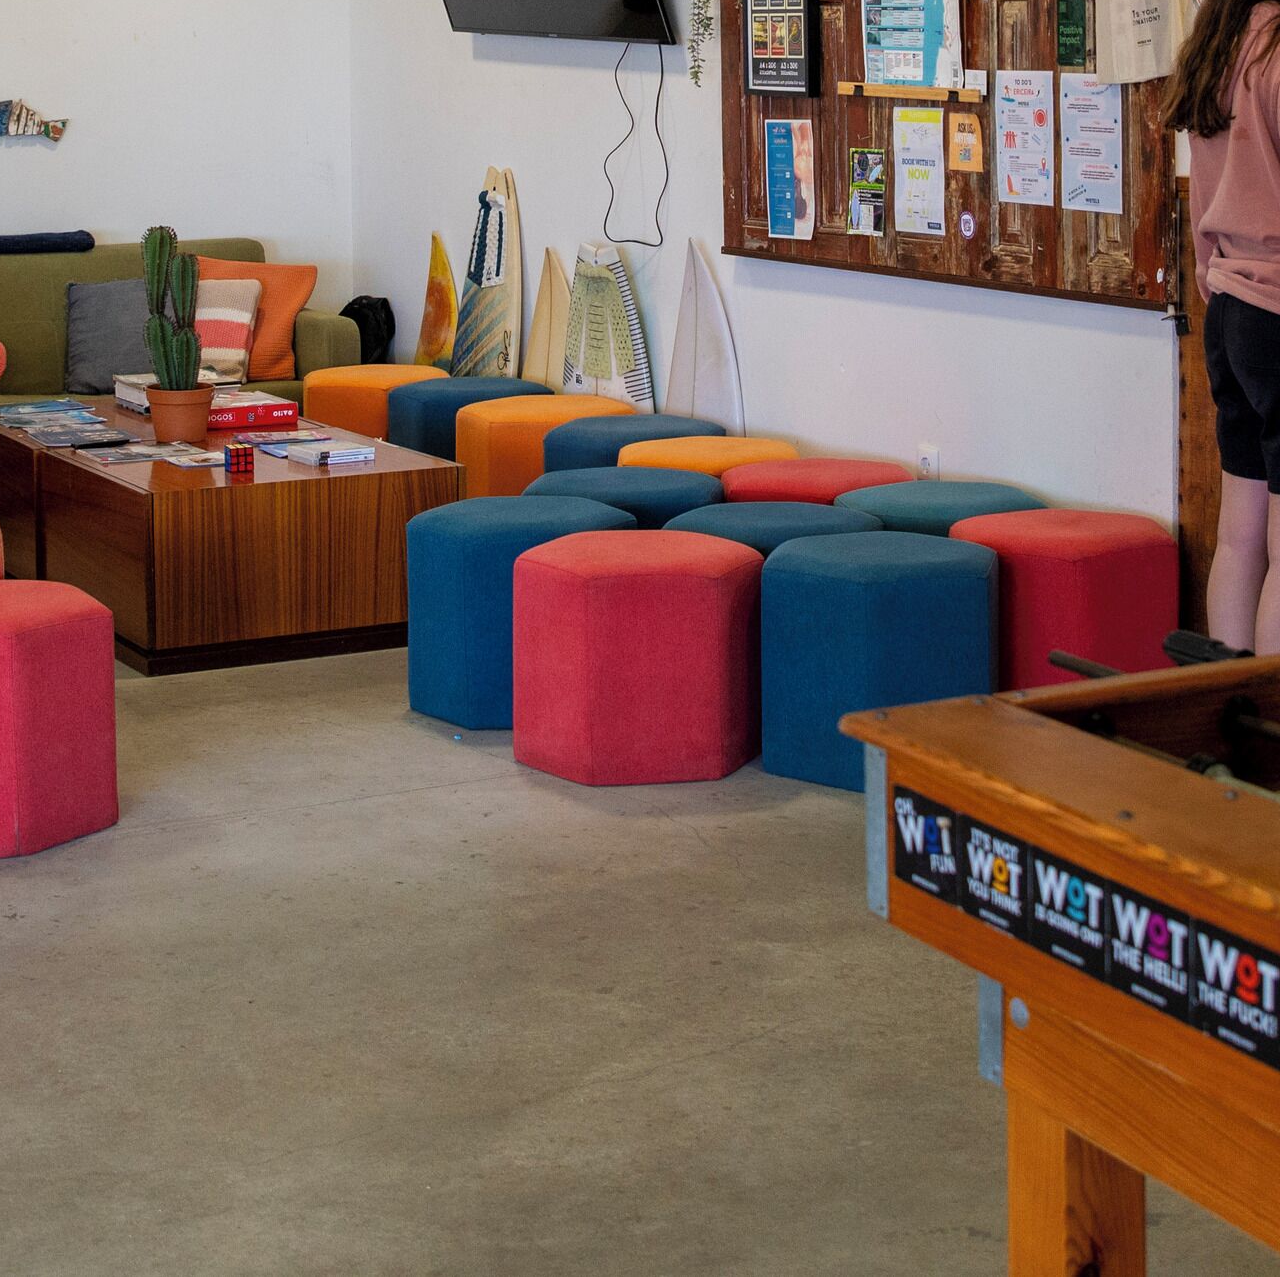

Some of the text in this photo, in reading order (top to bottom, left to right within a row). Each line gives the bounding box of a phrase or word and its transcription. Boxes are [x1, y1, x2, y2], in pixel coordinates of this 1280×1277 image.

[1060, 26, 1082, 34] Positive
[908, 168, 929, 180] NOW
[897, 814, 952, 855] WOT
[930, 854, 956, 873] FUN
[967, 842, 1021, 897] WOT
[1034, 859, 1104, 929] WOT
[1112, 893, 1188, 969] WOT
[1112, 938, 1143, 972] THE
[1198, 932, 1280, 1012] WOT
[1198, 981, 1228, 1014] THE
